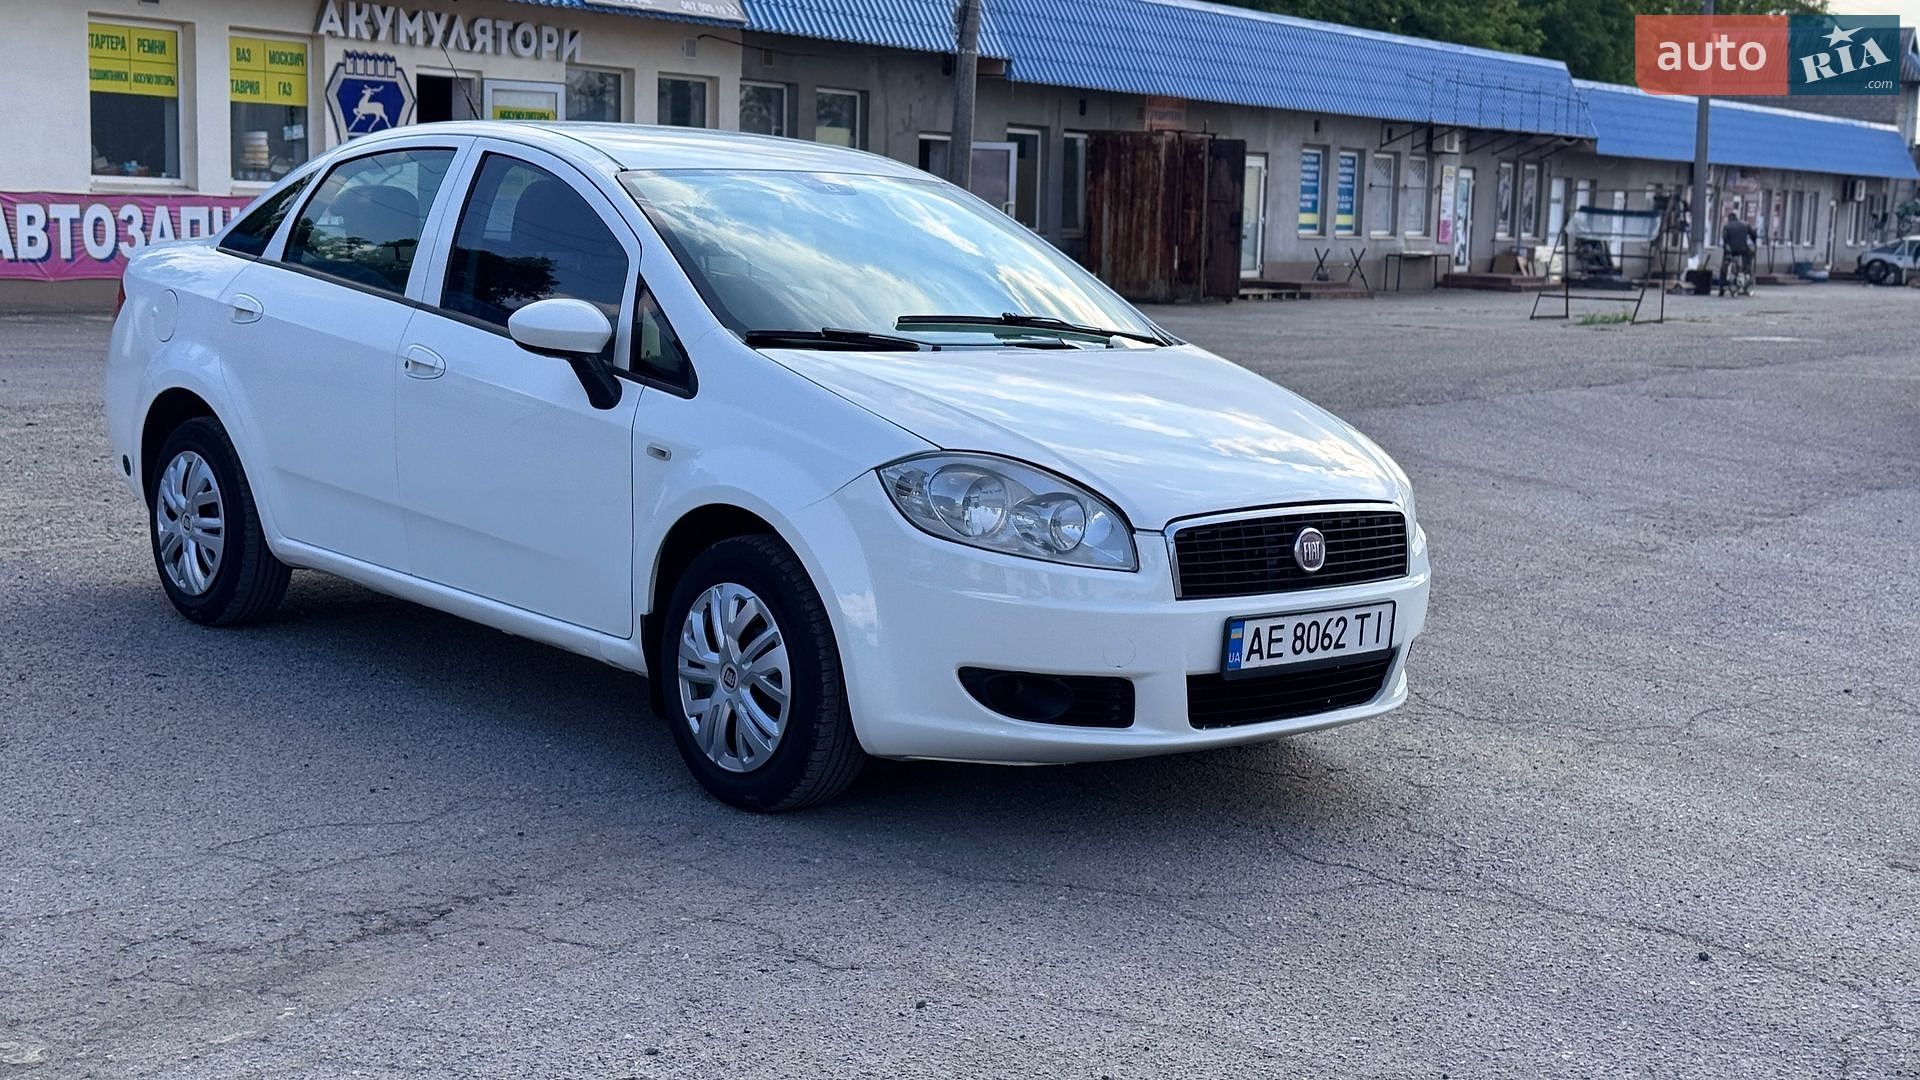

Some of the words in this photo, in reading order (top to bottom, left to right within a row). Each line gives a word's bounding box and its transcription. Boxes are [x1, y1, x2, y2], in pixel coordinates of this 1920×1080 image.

[316, 0, 583, 62] АКУМУЛЯТОРИ
[137, 38, 167, 55] РЕМНИ
[236, 47, 251, 63] ВАЗ
[268, 50, 305, 67] МОСКВИЧ
[230, 79, 260, 96] ТАВРИЯ
[277, 81, 292, 96] ГАЗ
[1303, 541, 1320, 561] FIAT
[1245, 624, 1285, 662] AE
[1292, 615, 1348, 656] 8062
[1228, 652, 1241, 664] UA
